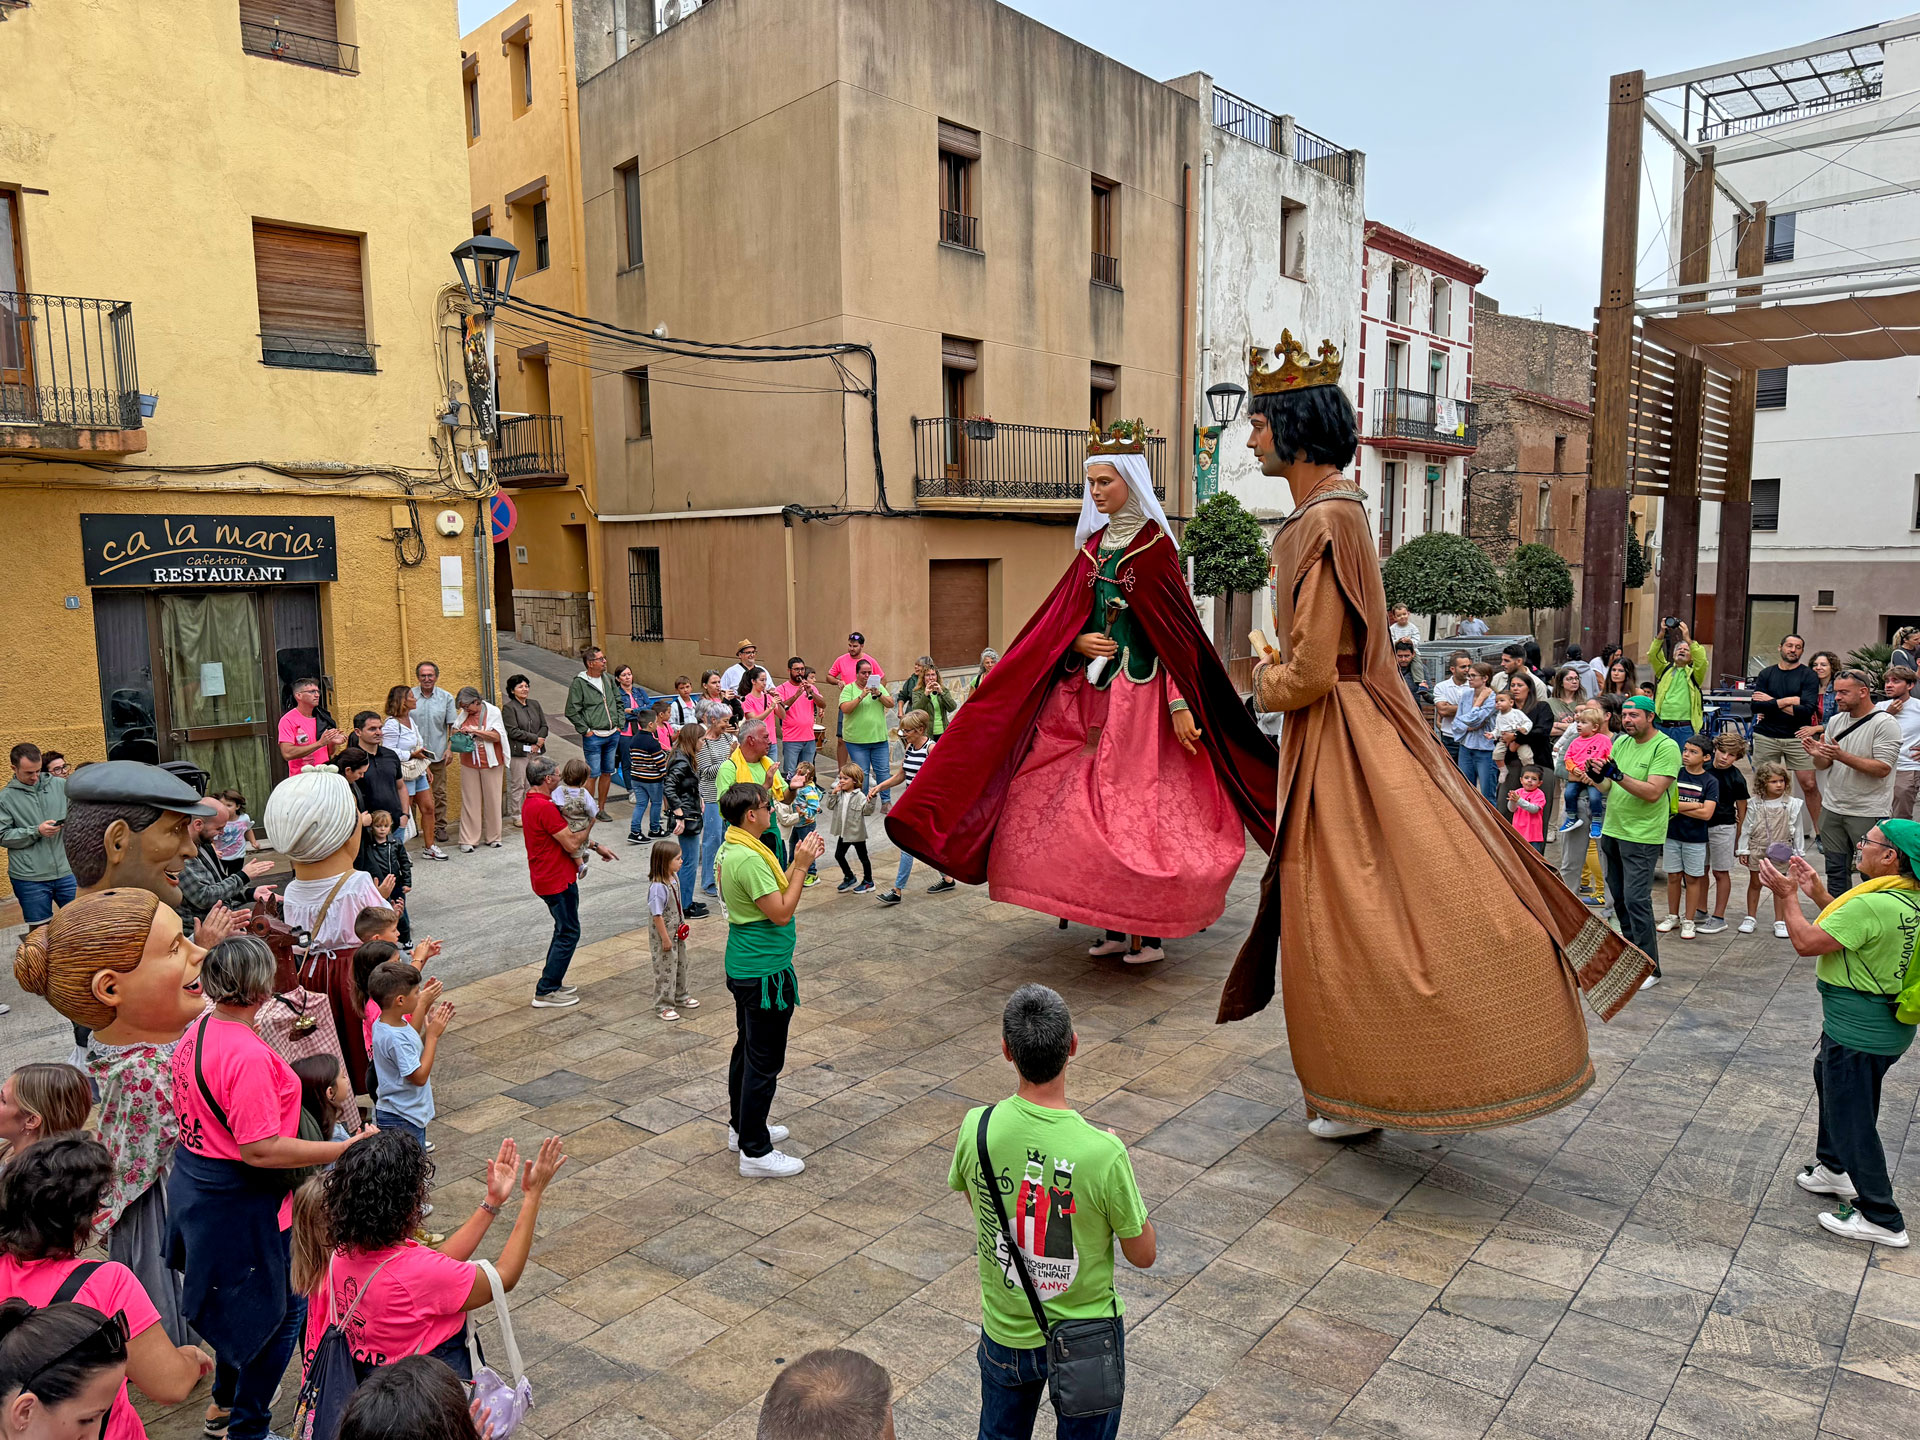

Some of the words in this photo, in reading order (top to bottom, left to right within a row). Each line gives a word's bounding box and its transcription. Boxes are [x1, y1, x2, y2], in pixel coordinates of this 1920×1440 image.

[103, 531, 150, 562] ca
[164, 518, 198, 546] la
[215, 524, 314, 554] maria
[316, 537, 325, 549] 2
[186, 555, 248, 566] Cafeteria
[153, 567, 285, 583] RESTAURANT
[1028, 1266, 1037, 1276] DE
[1038, 1270, 1071, 1280] L'INFANT
[1040, 1281, 1069, 1292] ANYS
[354, 1349, 387, 1367] CAP
